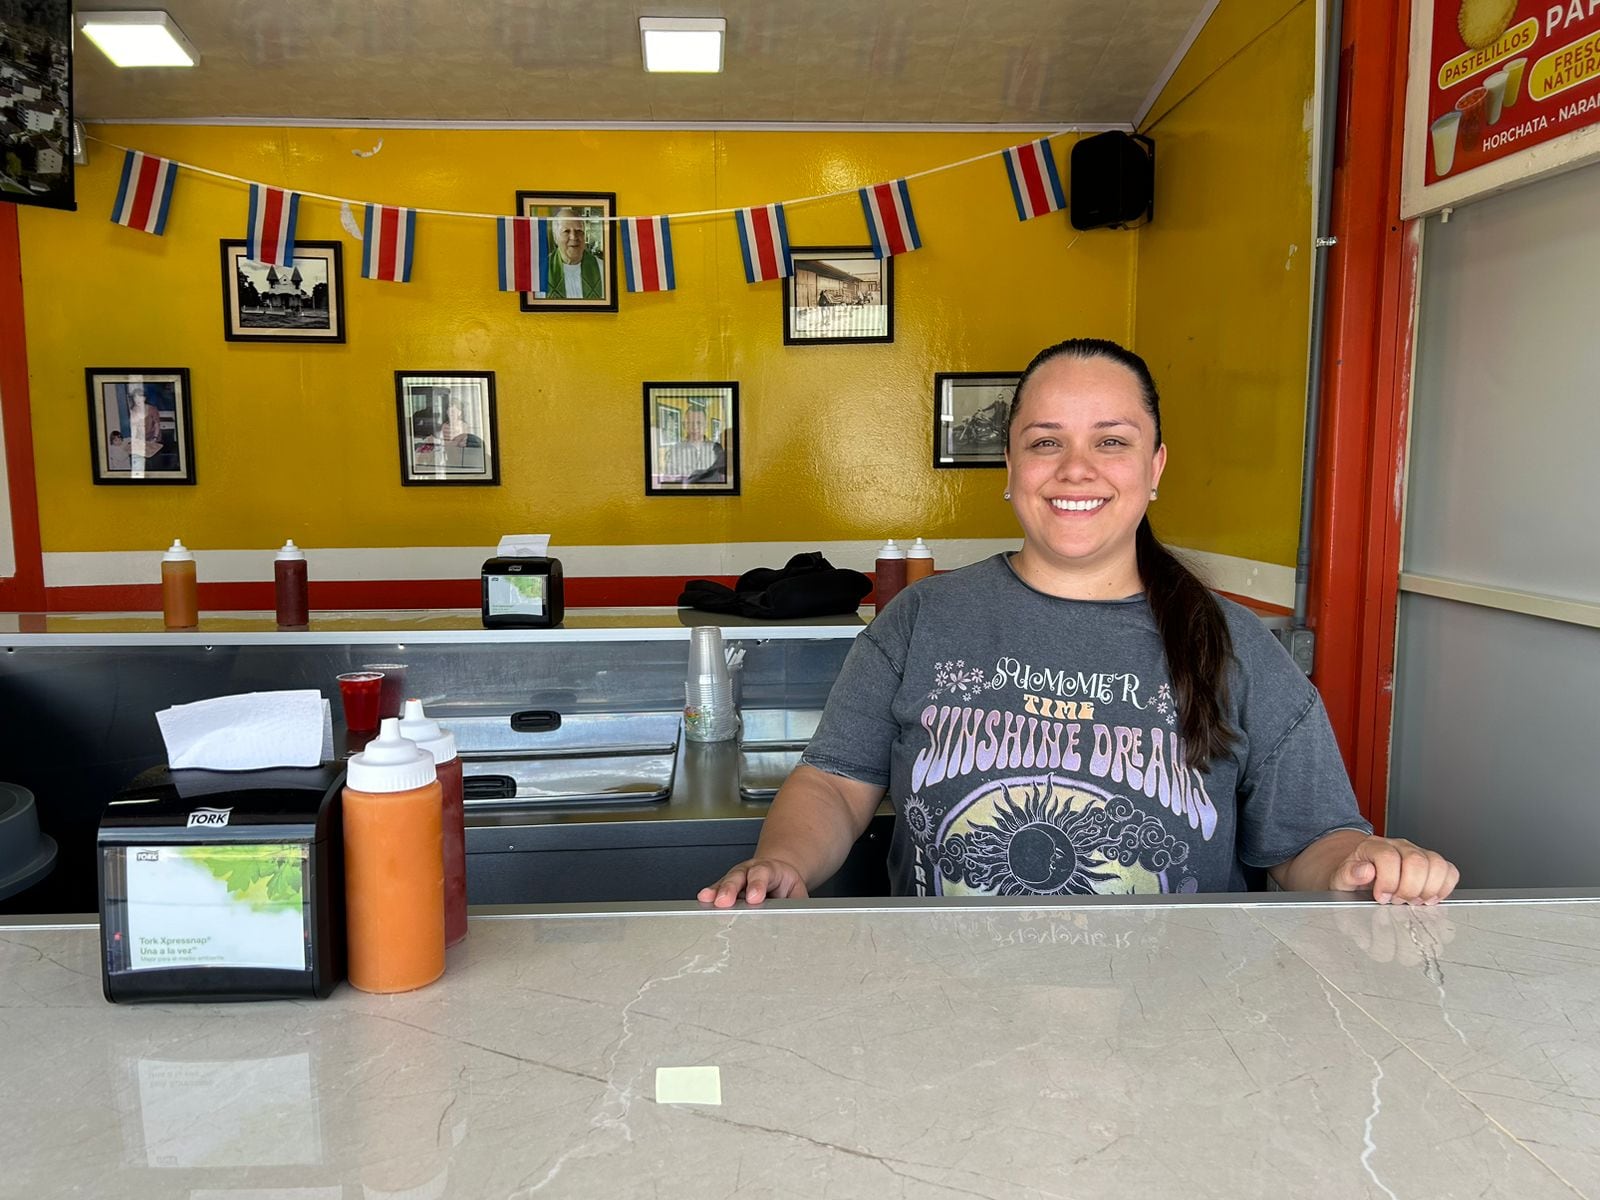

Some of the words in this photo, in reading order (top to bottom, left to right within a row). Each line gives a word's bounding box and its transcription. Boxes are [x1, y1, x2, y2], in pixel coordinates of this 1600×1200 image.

[1445, 28, 1530, 82] PASTELILLOS
[1482, 115, 1548, 152] HORCHATA
[991, 656, 1148, 710] SUMMER
[1023, 694, 1095, 721] TIME
[911, 704, 1082, 794] SUNSHINE
[1089, 723, 1218, 841] DREAMS
[190, 813, 228, 825] TORK
[138, 852, 158, 861] TORK
[140, 936, 158, 945] Tork
[140, 947, 158, 955] Una
[167, 947, 175, 955] la
